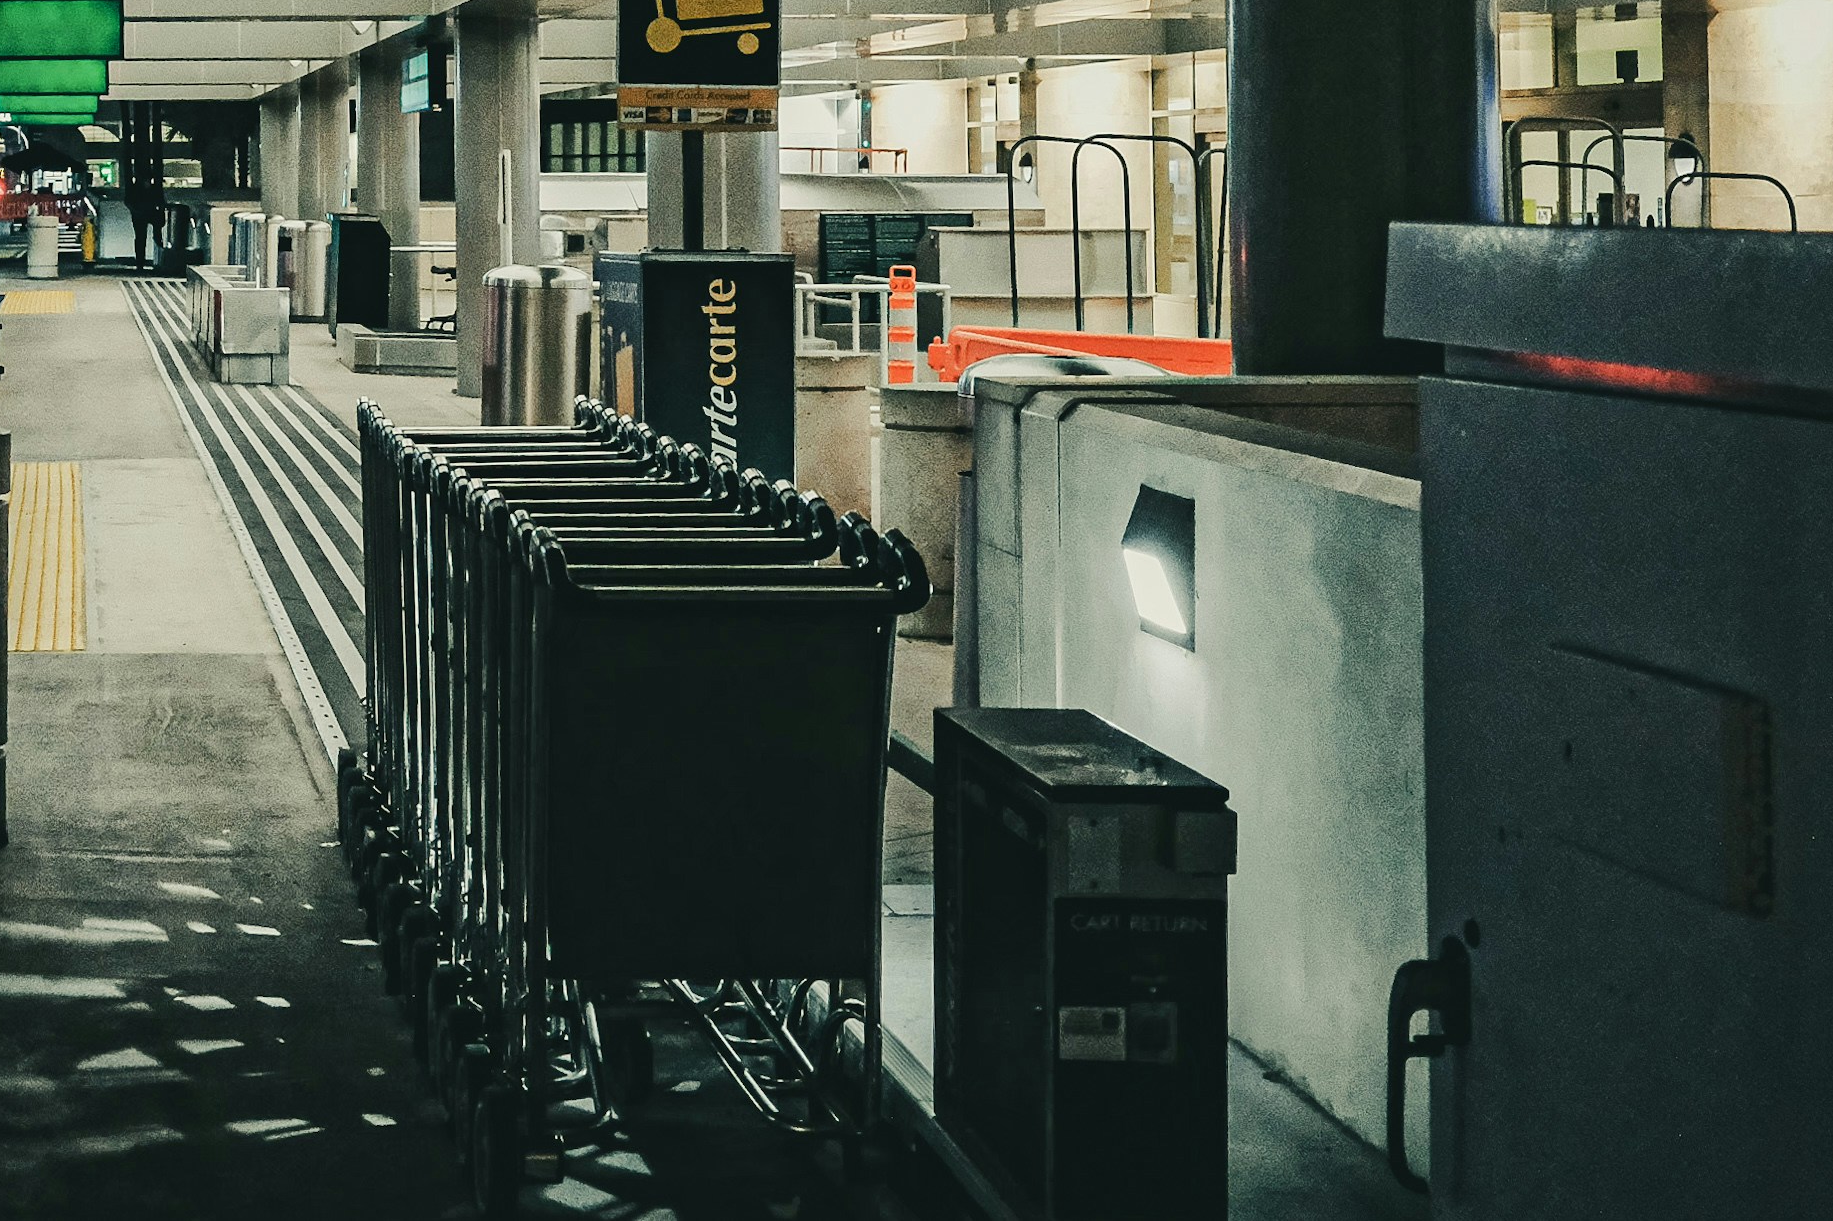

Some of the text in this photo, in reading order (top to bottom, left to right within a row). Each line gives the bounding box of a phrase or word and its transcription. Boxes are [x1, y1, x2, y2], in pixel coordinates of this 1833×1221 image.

[646, 89, 751, 103] Credit Cards Accepted
[623, 111, 644, 119] VISA
[1070, 913, 1208, 932] CART RETURN
